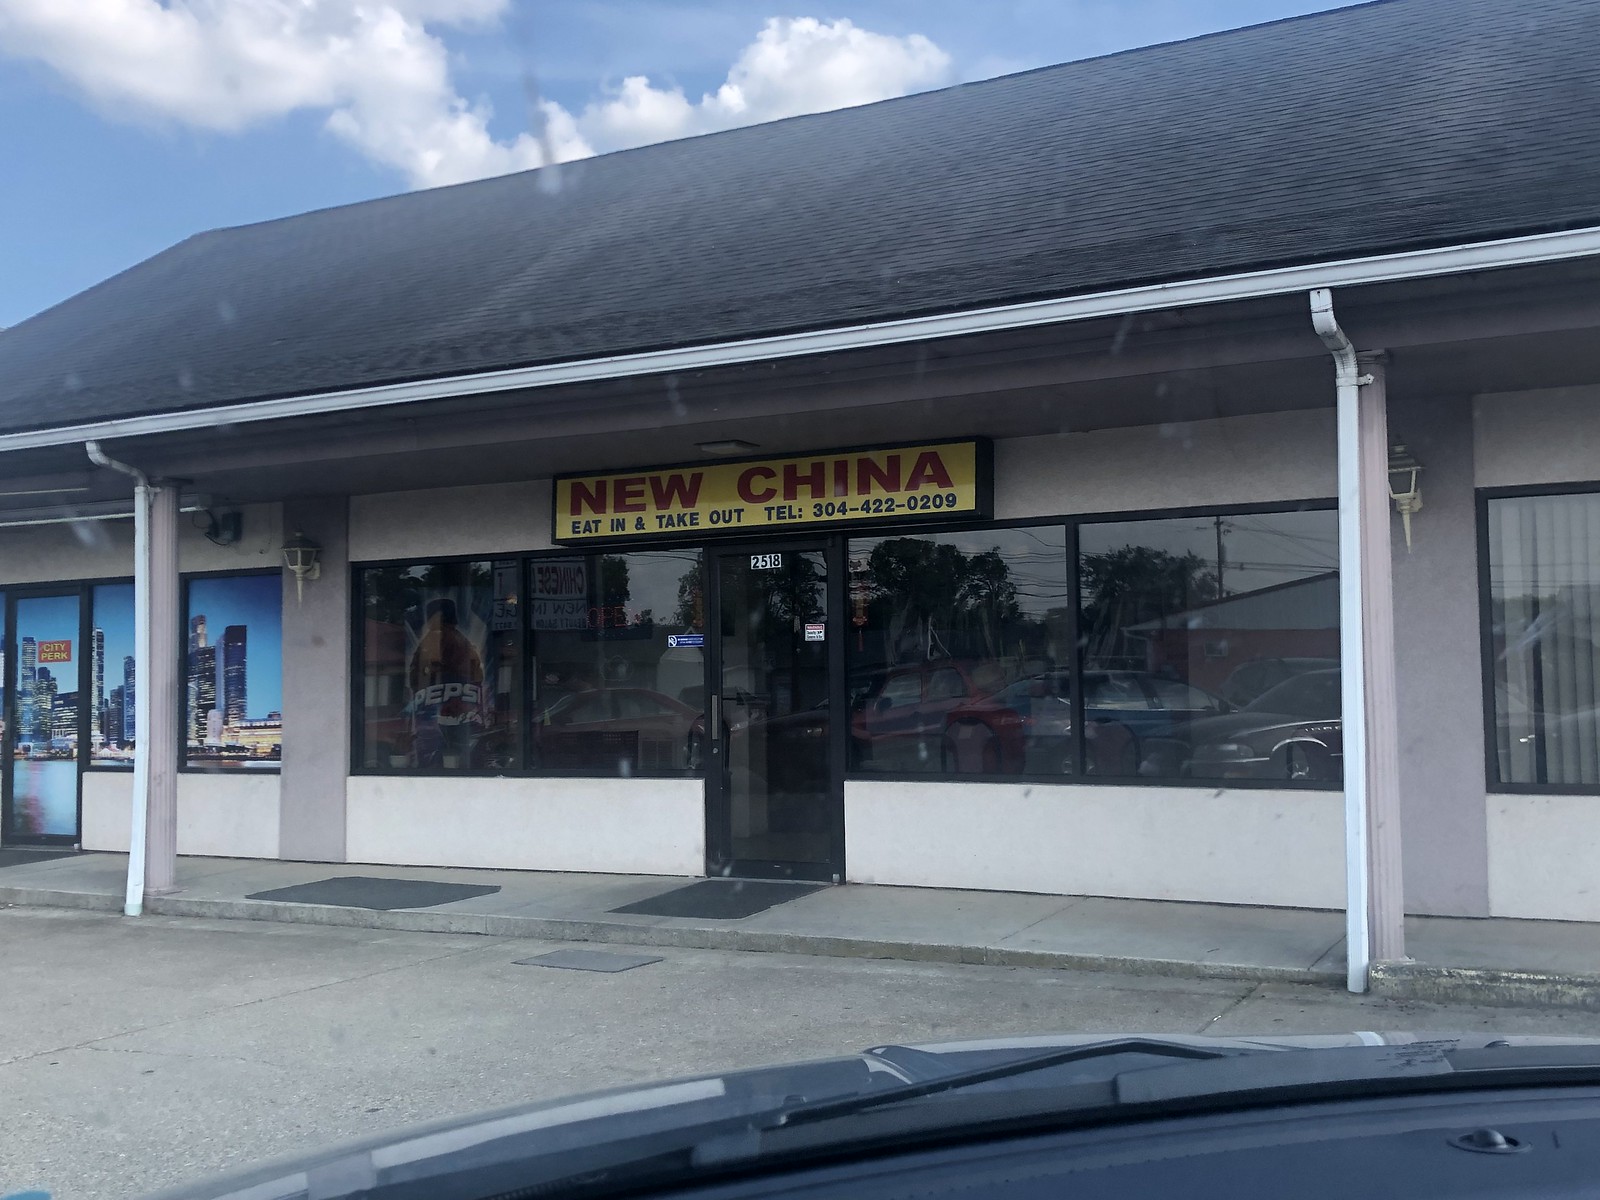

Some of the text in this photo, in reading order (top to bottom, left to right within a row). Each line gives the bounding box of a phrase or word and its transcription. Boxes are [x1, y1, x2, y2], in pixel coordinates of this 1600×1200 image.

[570, 451, 954, 516] NEW CHINA
[571, 493, 958, 535] EAT IN & TAKE OUT TEL: 304-422-0209
[752, 554, 780, 569] 2518
[43, 643, 66, 652] CITY
[41, 651, 68, 661] PERK
